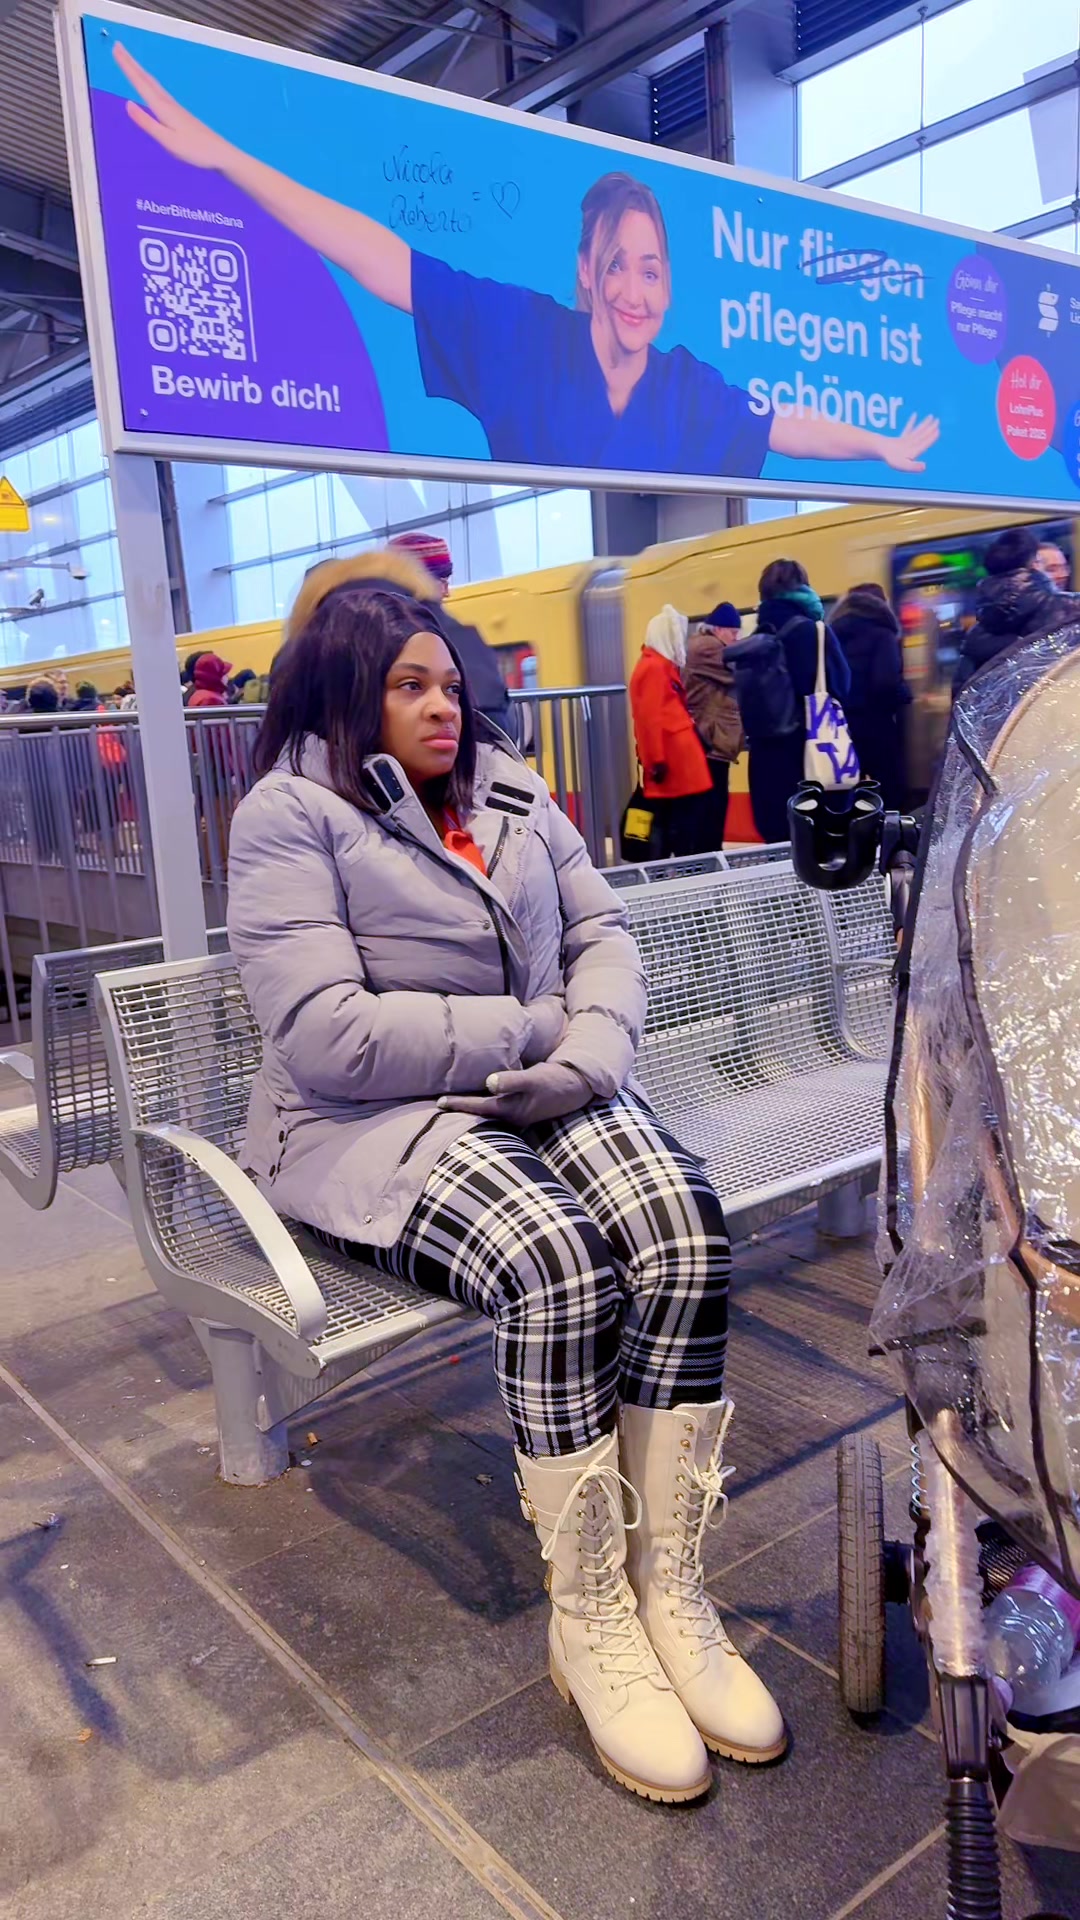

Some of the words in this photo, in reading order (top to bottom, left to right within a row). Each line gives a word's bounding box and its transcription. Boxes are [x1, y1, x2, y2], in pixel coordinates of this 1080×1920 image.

[136, 199, 244, 228] #AberBitteMitSana
[712, 205, 789, 271] Nur
[799, 228, 924, 302] fliegen
[720, 291, 868, 362] pflegen
[880, 314, 923, 367] ist
[951, 301, 977, 318] Pflege
[977, 309, 1003, 322] macht
[956, 322, 971, 333] nur
[972, 322, 998, 340] Pflege
[151, 364, 263, 404] Bewirb
[271, 379, 341, 412] dich!
[748, 371, 904, 430] schöner
